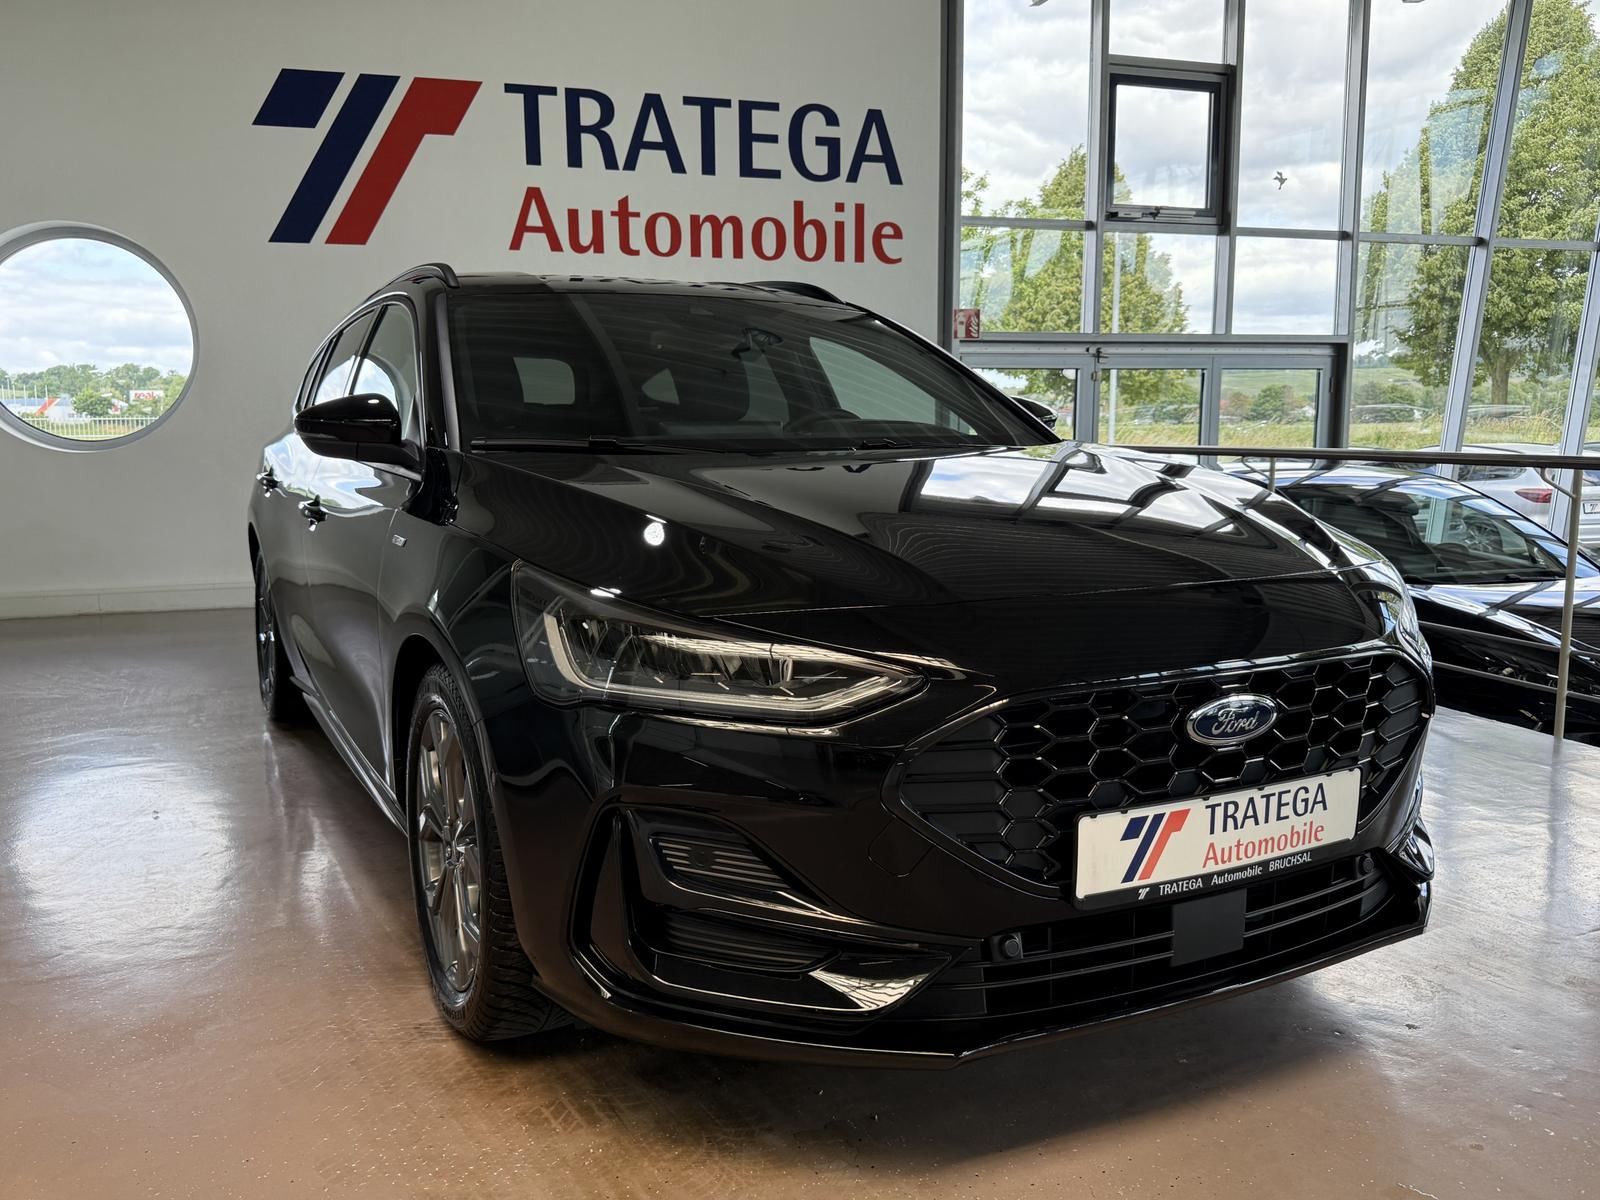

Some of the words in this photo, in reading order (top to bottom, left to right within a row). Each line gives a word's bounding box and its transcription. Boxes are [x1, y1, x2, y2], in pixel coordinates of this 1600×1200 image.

[504, 83, 903, 185] TRATEGA
[509, 186, 904, 264] Automobile
[1212, 706, 1260, 735] Ford
[1205, 782, 1328, 835] TRATEGA
[1202, 821, 1325, 868] Automobile
[1159, 877, 1203, 896] TRATEGA
[1211, 865, 1263, 885] Automobile
[1268, 851, 1312, 872] BRUCHSAL
